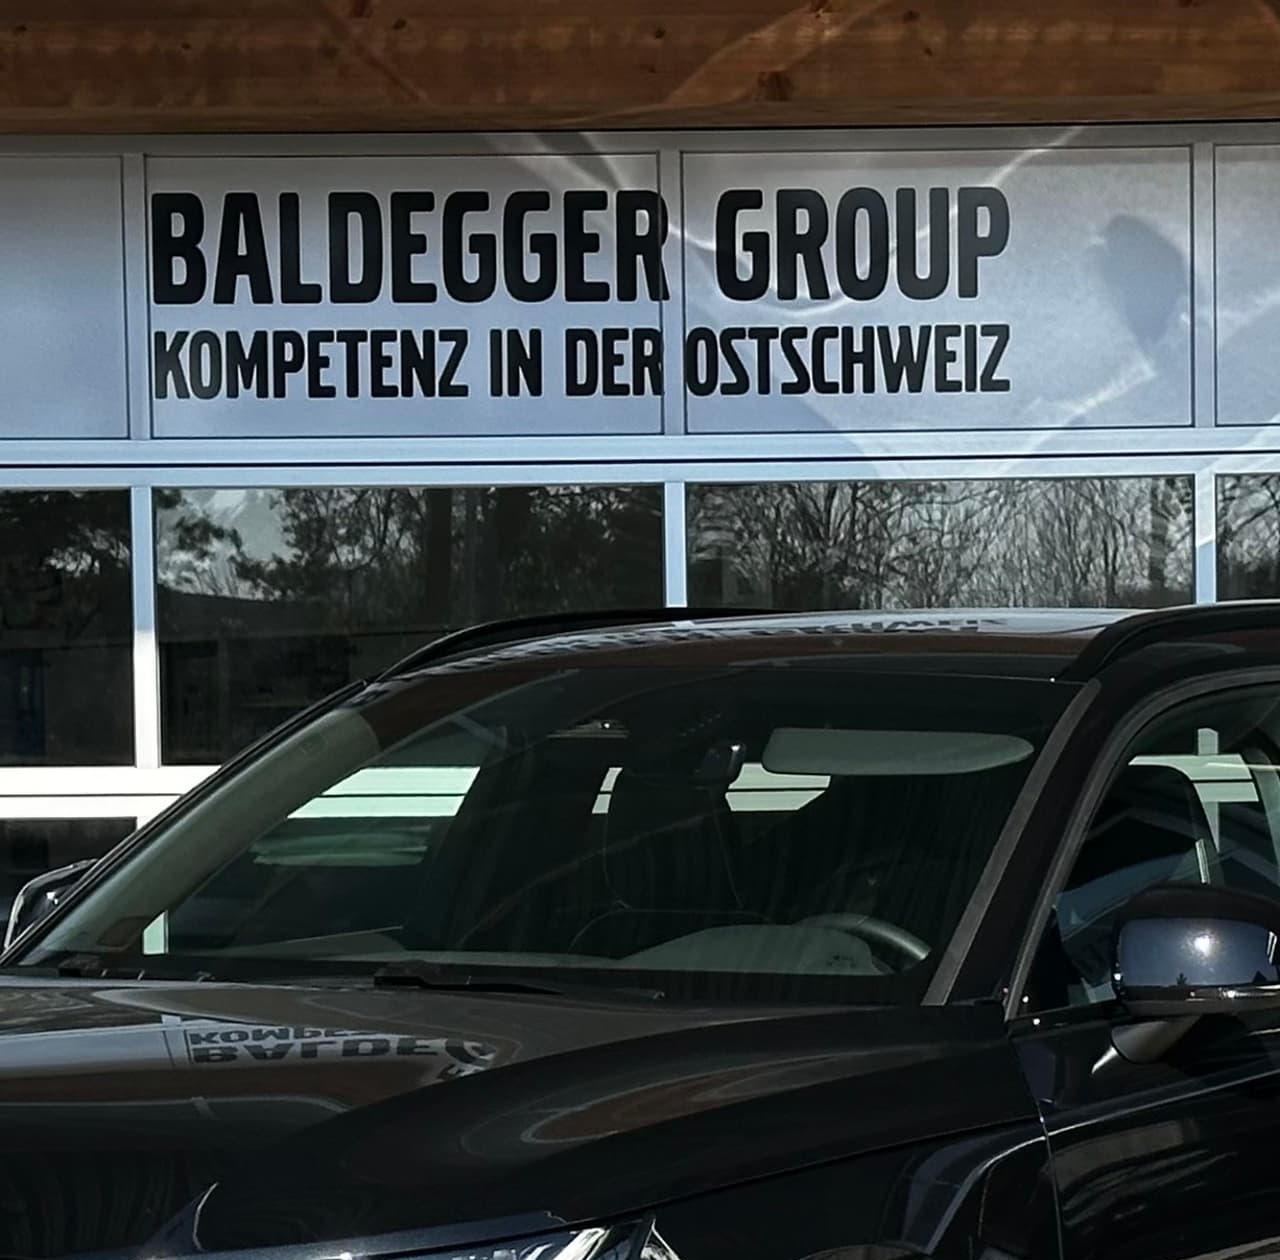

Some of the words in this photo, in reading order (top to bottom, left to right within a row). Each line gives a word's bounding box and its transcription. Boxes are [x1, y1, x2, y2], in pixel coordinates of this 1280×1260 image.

[151, 189, 670, 305] BALDEGGER
[716, 187, 1010, 300] GROUP
[153, 327, 468, 400] KOMPETENZ
[490, 329, 542, 397] IN
[565, 328, 663, 397] DER
[684, 324, 1010, 397] OSTSCHWEIZ
